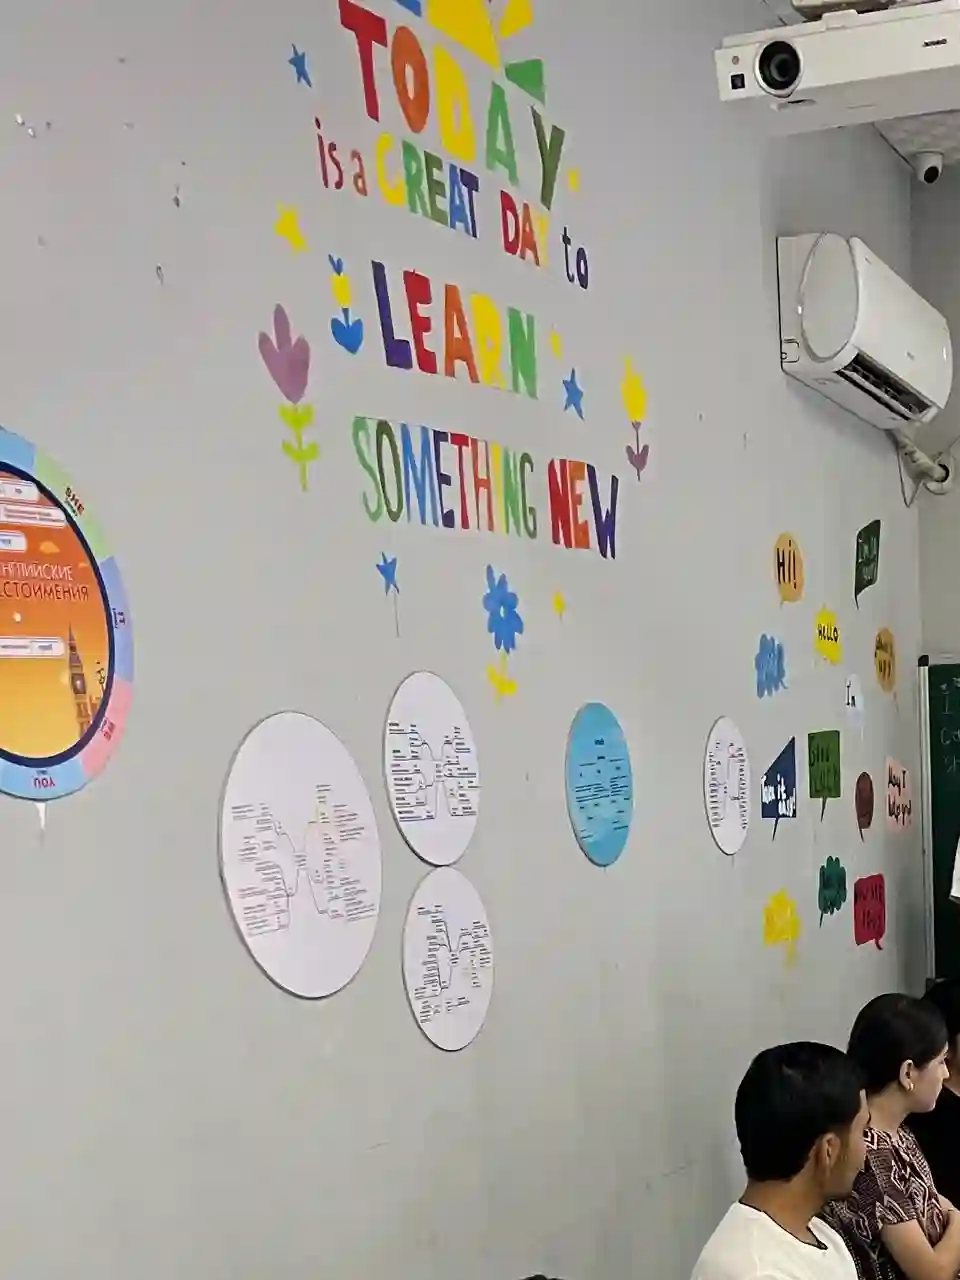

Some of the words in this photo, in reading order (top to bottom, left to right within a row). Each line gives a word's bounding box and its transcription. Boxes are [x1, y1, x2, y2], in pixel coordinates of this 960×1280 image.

[338, 0, 566, 211] TODAY
[314, 116, 344, 190] is
[350, 148, 368, 197] a
[376, 132, 479, 239] GREAT
[499, 190, 549, 267] DAY
[561, 226, 589, 290] to
[370, 260, 539, 399] LEARN
[352, 415, 539, 540] SOMETHING
[547, 457, 620, 560] NEW
[0, 559, 73, 581] НГЛИЙСКИЕ
[0, 580, 89, 602] СТОИМЕНИЯ
[776, 538, 798, 590] Hi!
